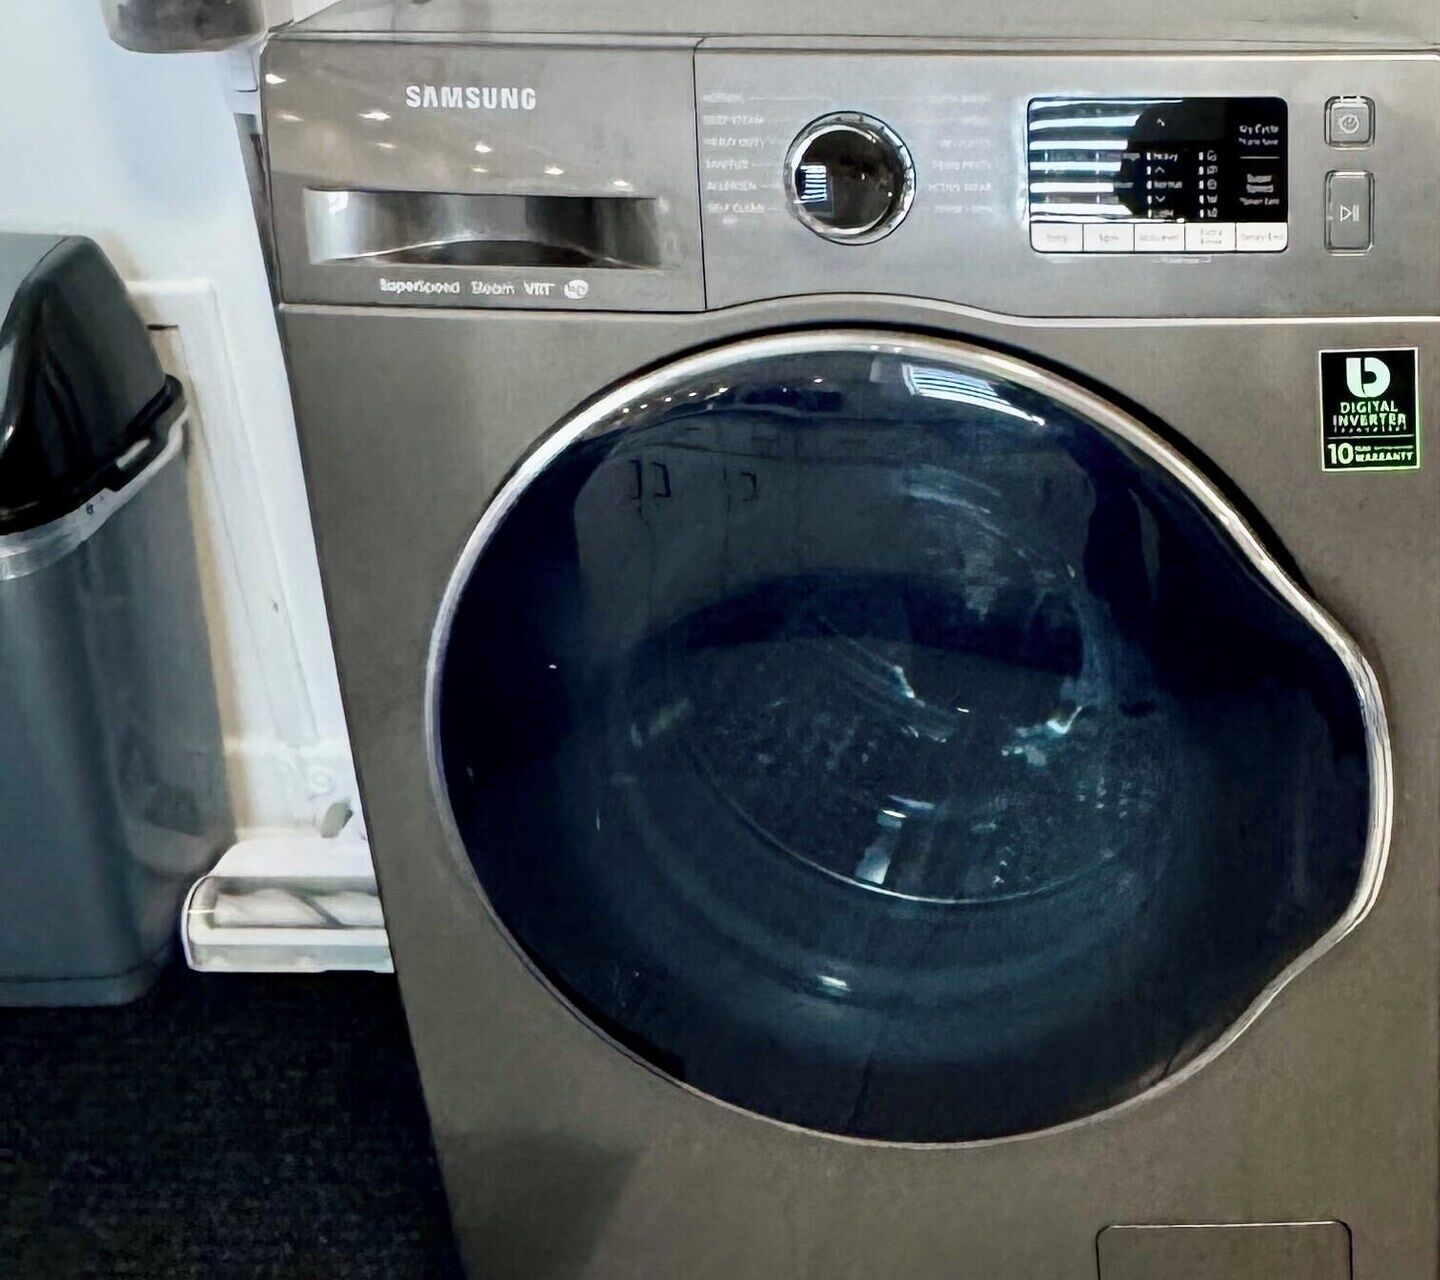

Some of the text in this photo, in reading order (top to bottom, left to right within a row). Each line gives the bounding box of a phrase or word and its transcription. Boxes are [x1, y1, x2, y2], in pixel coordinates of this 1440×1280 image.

[406, 85, 536, 110] SAMSUNG
[1340, 400, 1399, 414] DIGITAL
[1332, 413, 1407, 428] INVERTER
[1327, 442, 1355, 464] 10
